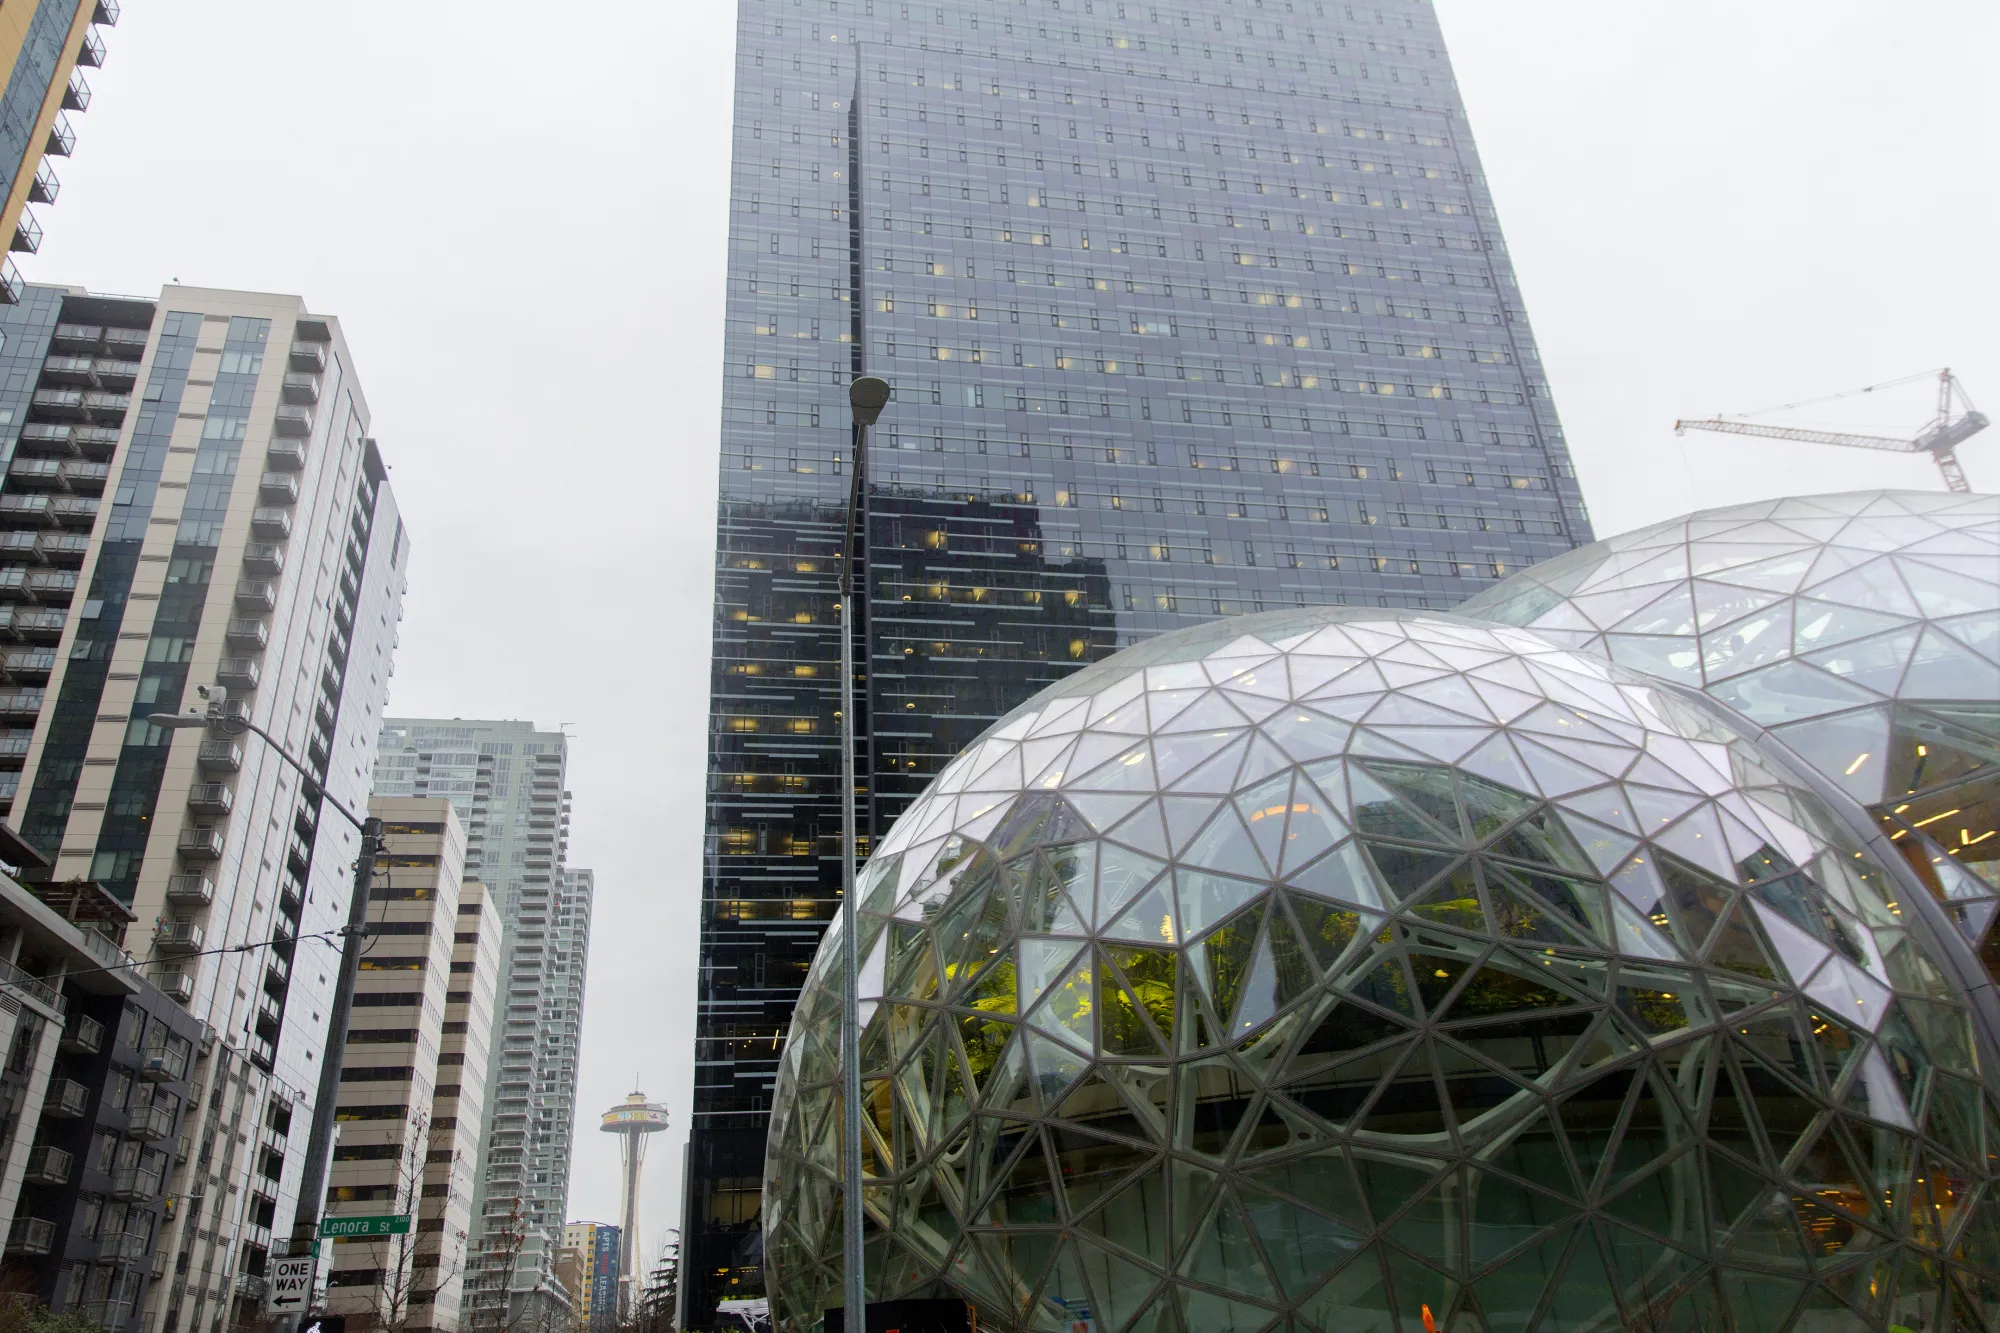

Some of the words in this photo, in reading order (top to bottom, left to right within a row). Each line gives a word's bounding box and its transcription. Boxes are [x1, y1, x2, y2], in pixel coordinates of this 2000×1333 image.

[395, 1215, 410, 1223] 2100
[323, 1219, 369, 1234] Lenora
[379, 1221, 391, 1232] St
[602, 1231, 610, 1252] APTS
[278, 1263, 309, 1276] ONE
[276, 1278, 308, 1291] WAY
[597, 1276, 607, 1311] LEASING
